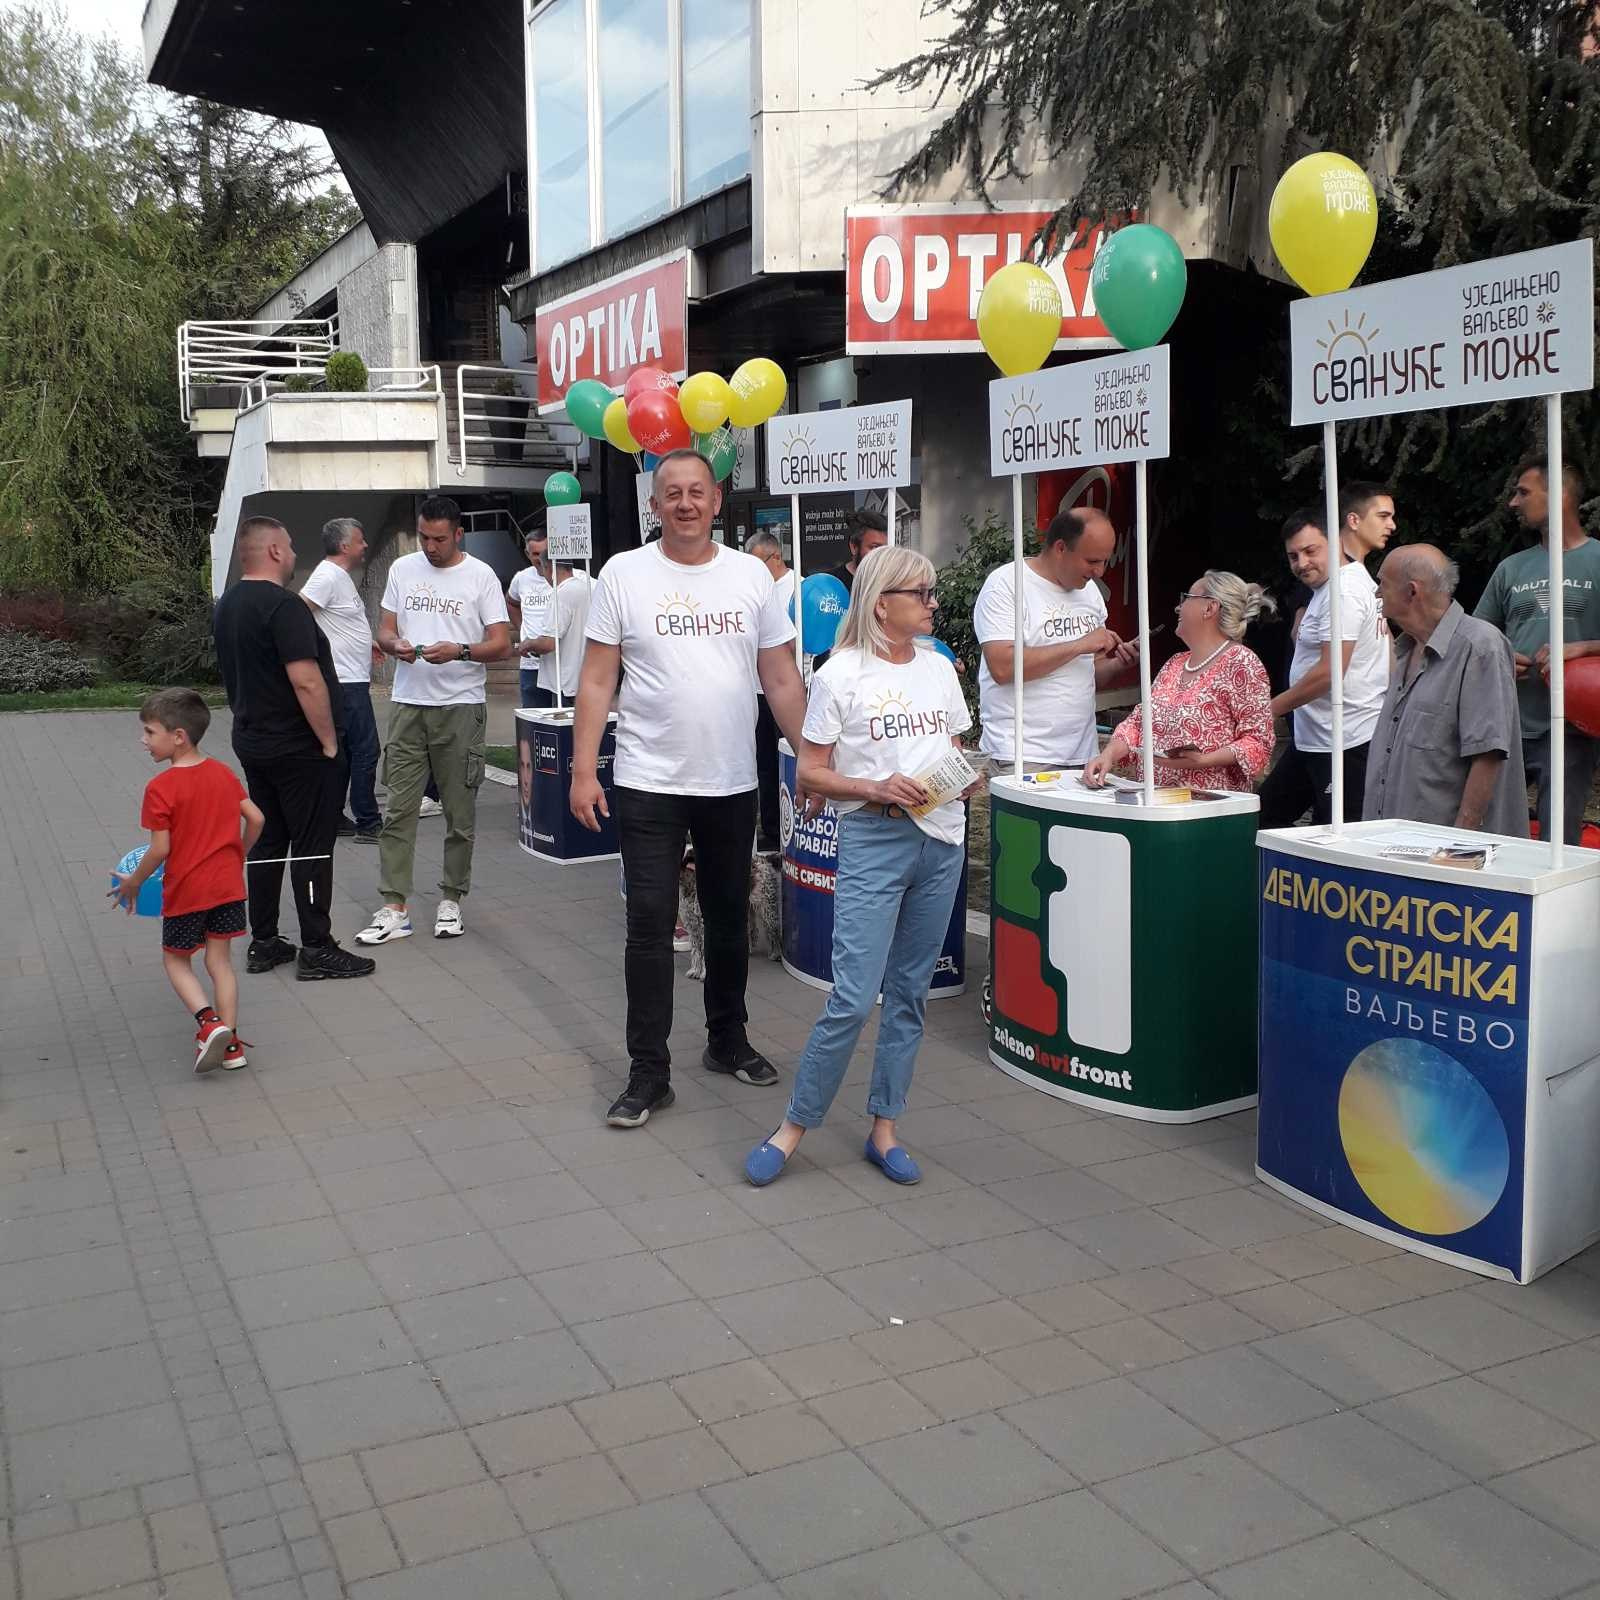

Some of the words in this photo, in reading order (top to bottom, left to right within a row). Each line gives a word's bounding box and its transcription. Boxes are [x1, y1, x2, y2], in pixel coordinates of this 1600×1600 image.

[1463, 269, 1561, 310] УЈЕДИЊЕНО
[550, 286, 663, 388] OPTIKA
[1463, 304, 1528, 336] ВАЉЕВО
[1094, 362, 1151, 391] УЈЕДИЊЕНО
[1312, 342, 1446, 405] СВАНУЋЕ
[1463, 328, 1561, 385] МОЖЕ
[1094, 389, 1133, 413] ВАЉЕВО
[1002, 417, 1082, 463] СВАНУЋЕ
[1095, 410, 1150, 453] МОЖЕ
[780, 451, 848, 486] СВАНУЋЕ
[857, 449, 898, 480] МОЖЕ
[404, 595, 464, 616] СВАНУЋЕ
[655, 611, 746, 637] СВАНУЋЕ
[794, 831, 838, 859] ПРАВДЕ
[800, 867, 837, 891] СРБИЈ
[1263, 867, 1519, 953] ДЕМОКРАТСКА
[1345, 935, 1517, 1005] СТРАНКА
[1346, 987, 1515, 1050] ВАЉЕВО
[994, 1025, 1132, 1091] zelenolevifront
